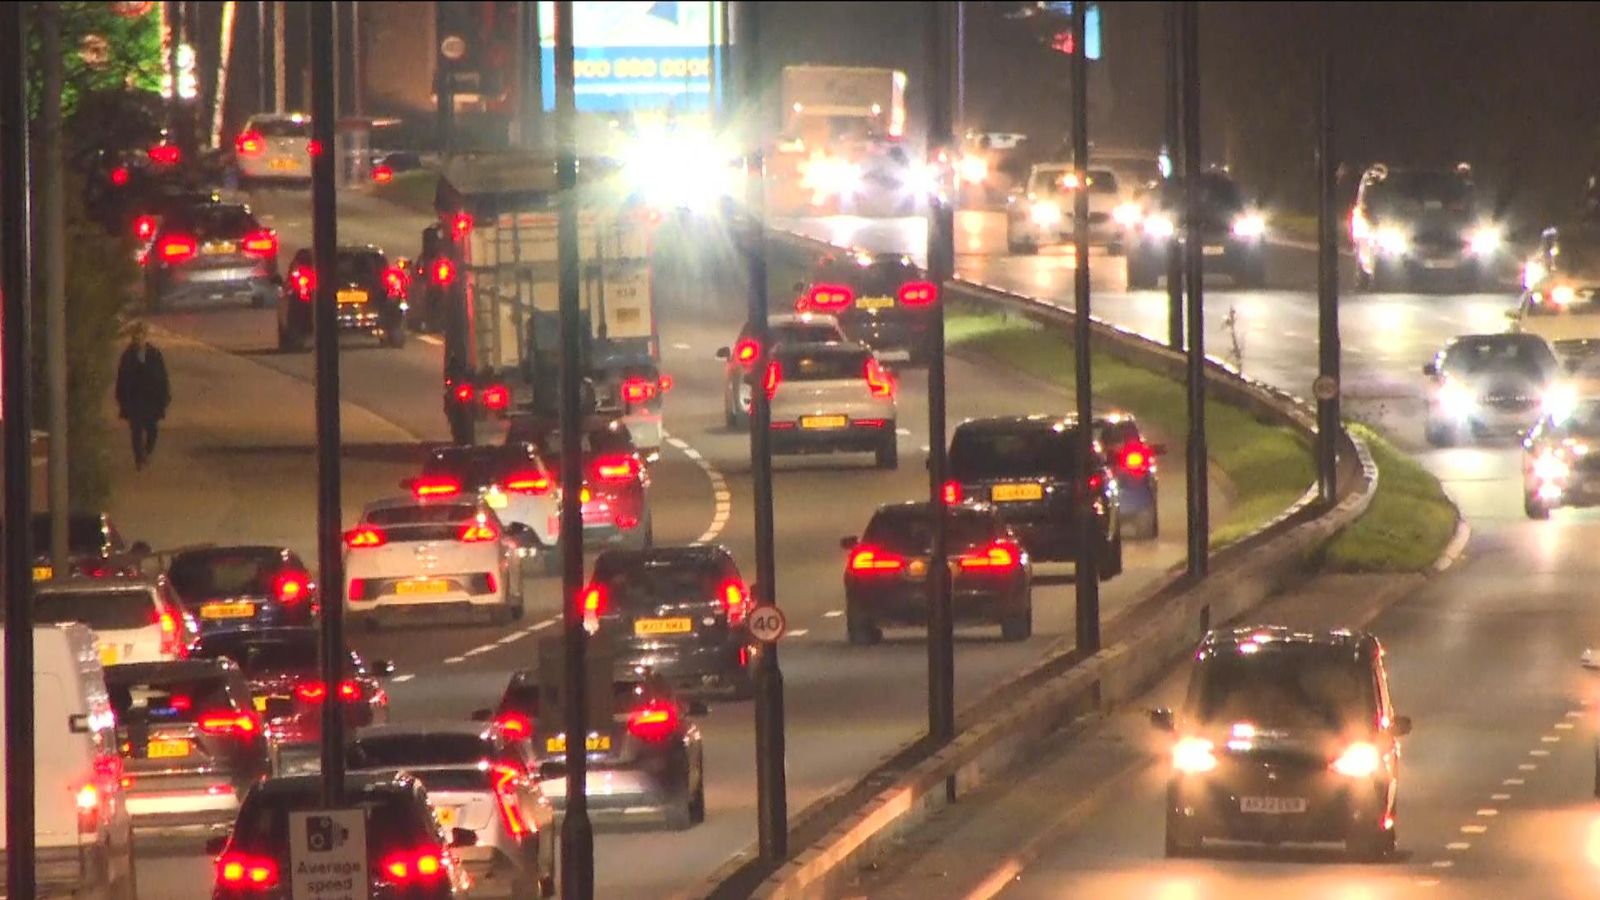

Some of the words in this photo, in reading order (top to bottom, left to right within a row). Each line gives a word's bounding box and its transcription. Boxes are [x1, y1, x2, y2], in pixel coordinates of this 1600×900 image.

[754, 615, 780, 631] 40
[296, 861, 362, 875] Average
[307, 877, 353, 894] speed
